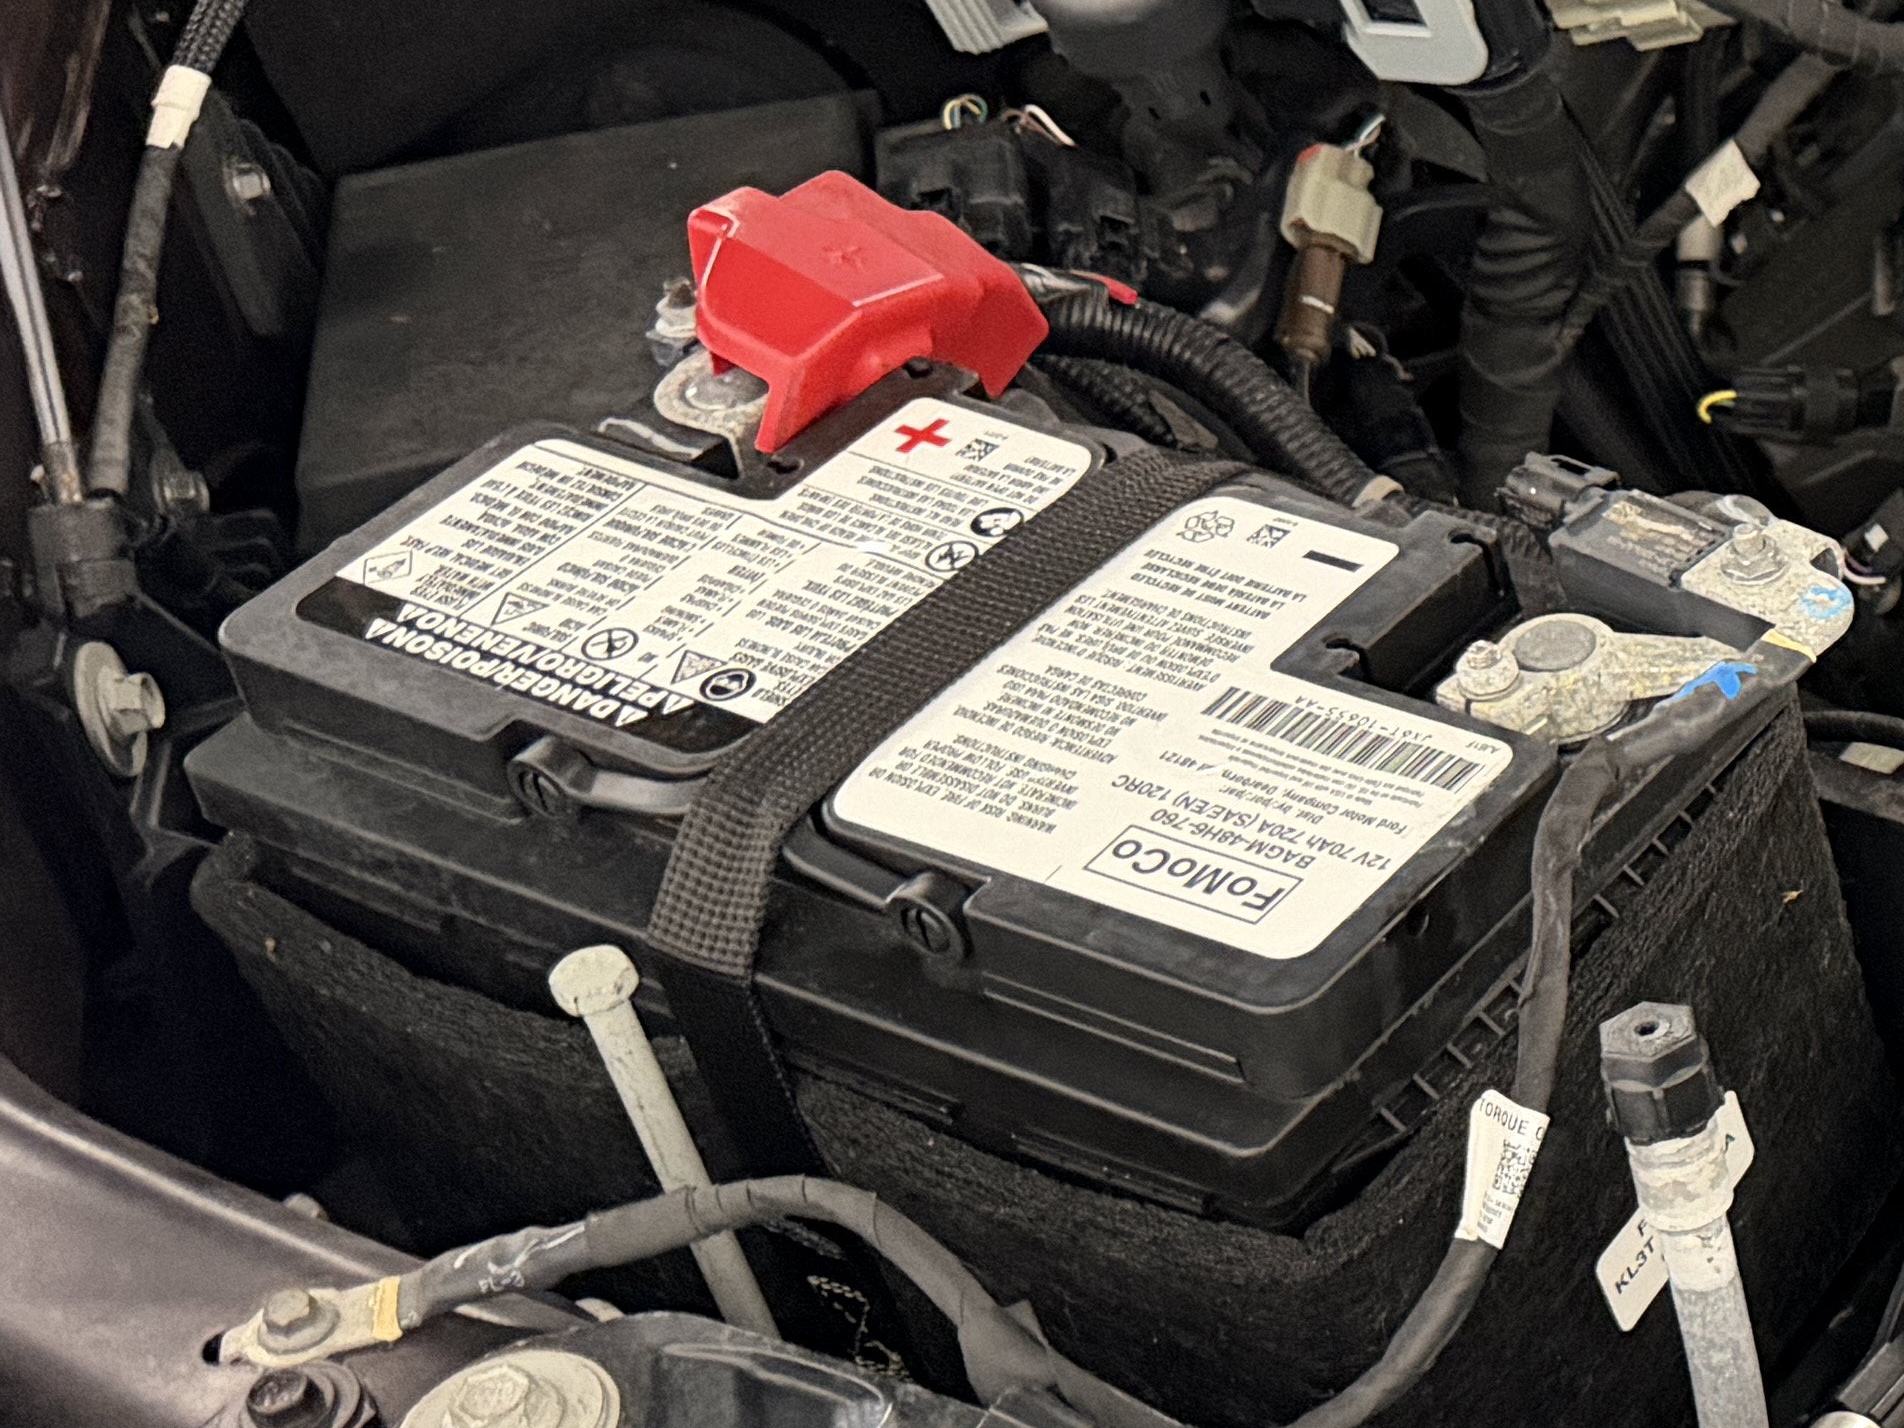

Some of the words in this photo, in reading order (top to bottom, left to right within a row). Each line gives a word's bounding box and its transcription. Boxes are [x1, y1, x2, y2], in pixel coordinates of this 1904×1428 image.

[1139, 561, 1203, 584] RECICLARSE
[1217, 570, 1247, 584] DOIT
[1127, 572, 1183, 593] RECYCLED
[1199, 579, 1229, 593] DEBE
[1242, 578, 1294, 598] BATTERIE
[1072, 593, 1097, 606] LES
[1179, 587, 1198, 598] BE
[1193, 591, 1228, 606] MUST
[1289, 591, 1308, 602] LA
[1223, 600, 1272, 619] BATTERY
[1267, 599, 1286, 610] LA
[1062, 604, 1126, 629] UTILISATION
[1091, 599, 1171, 628] ATTENTIVEMENT
[1164, 607, 1184, 618] DE
[1035, 621, 1061, 635] PAS
[1065, 618, 1092, 631] NON
[1121, 621, 1146, 634] UNE
[1165, 621, 1205, 638] SUIVEZ
[1177, 611, 1254, 639] INSTRUCTIONS
[1056, 628, 1075, 639] NE
[1141, 627, 1174, 642] POUR
[1141, 641, 1162, 652] OU
[410, 607, 671, 711] PELIGRO/VENENO
[1124, 649, 1143, 660] DE
[1138, 652, 1160, 665] OU
[379, 622, 623, 723] DANGER/POISON
[994, 663, 1074, 693] INSTRUCCIONES
[1075, 674, 1094, 686] DE
[1000, 679, 1028, 693] USO
[1021, 685, 1053, 701] PARA
[1068, 686, 1092, 699] LAS
[1089, 678, 1149, 702] CORRECTAS
[1087, 692, 1116, 706] SIGA
[1038, 705, 1056, 716] NI
[1047, 693, 1123, 722] RECOMENDADO
[996, 720, 1016, 732] DE
[1051, 709, 1108, 732] DESMONTE
[1117, 715, 1137, 727] NO
[1009, 724, 1052, 744] RIESGO
[1102, 725, 1122, 737] NO
[896, 745, 923, 760] FOR
[921, 738, 966, 758] PROPER
[892, 759, 915, 772] OR
[961, 751, 1007, 771] FOLLOW
[1157, 749, 1200, 769] 48121
[866, 766, 888, 778] OR
[916, 752, 998, 784] RECOMMENDED
[881, 771, 942, 797] EXPLOSION
[908, 764, 981, 794] DISASSEMBLE
[992, 776, 1018, 791] NOT
[975, 786, 1002, 800] NOT
[1108, 772, 1174, 802] 120RC
[962, 797, 983, 810] OF
[996, 792, 1018, 805] DO
[977, 803, 1007, 818] RISK
[1168, 789, 1262, 830] (SAE/EN)
[1337, 807, 1378, 826] Motor
[1253, 817, 1307, 844] 720A
[1374, 818, 1407, 835] Ford
[1146, 805, 1318, 871] BAGM-48H6-760
[1301, 833, 1357, 860] 70Ah
[1351, 848, 1393, 872] 12V
[1099, 835, 1286, 914] FoMoCo
[1478, 1096, 1527, 1137] TORQUE
